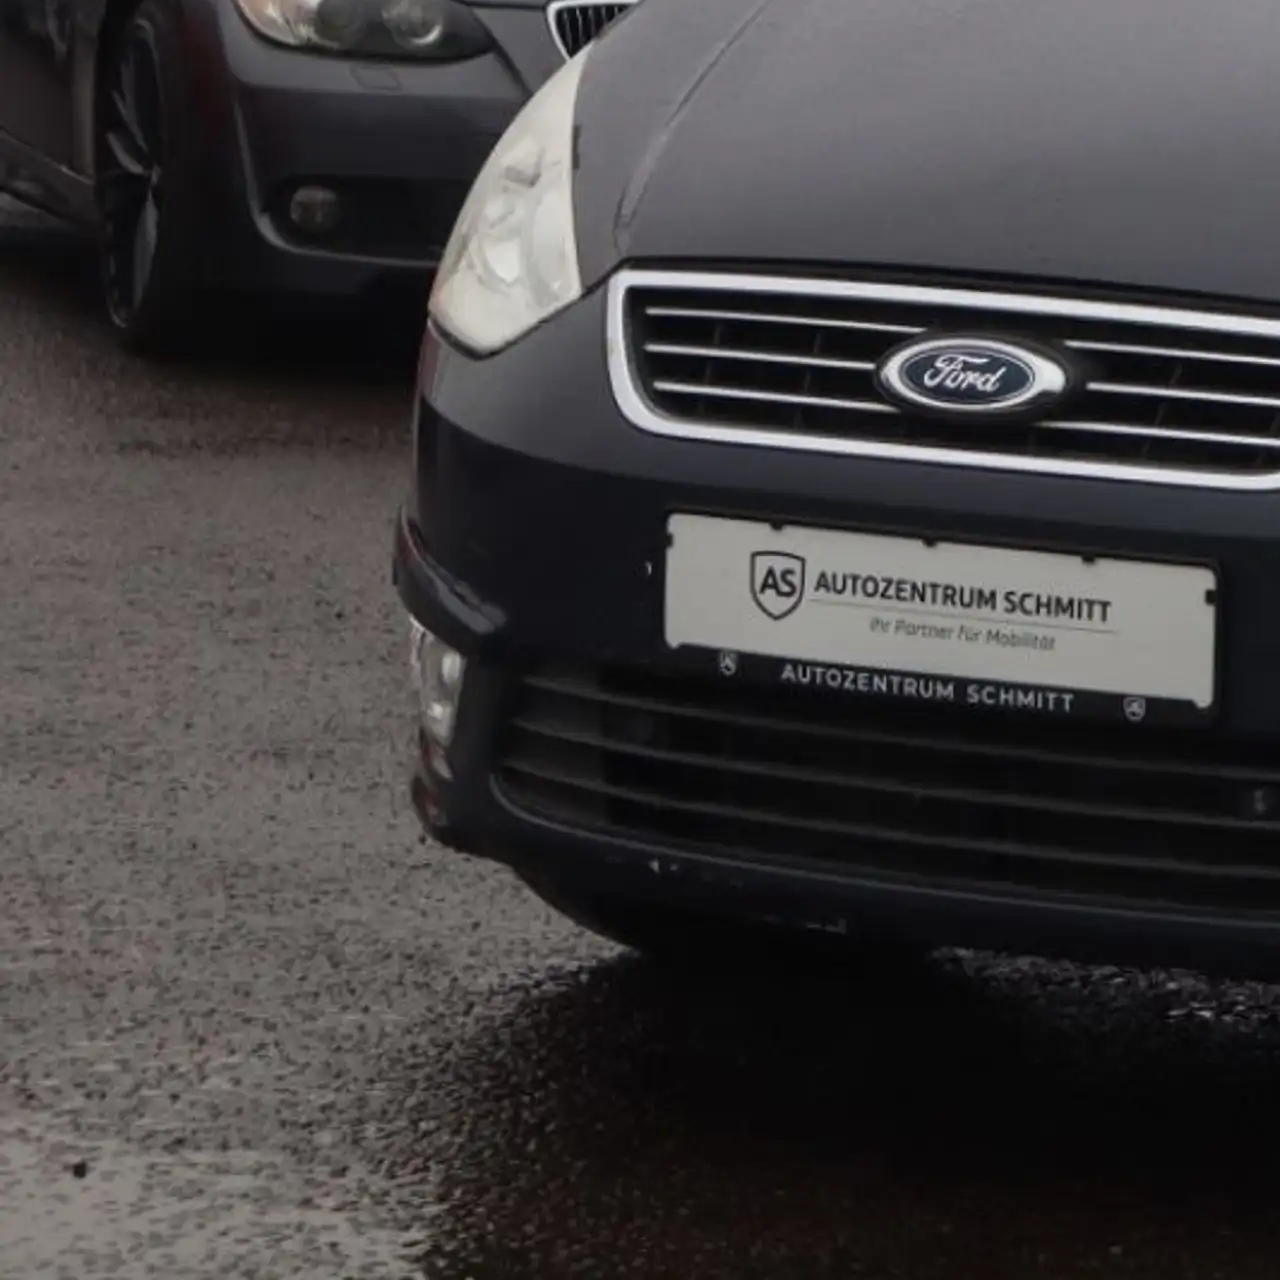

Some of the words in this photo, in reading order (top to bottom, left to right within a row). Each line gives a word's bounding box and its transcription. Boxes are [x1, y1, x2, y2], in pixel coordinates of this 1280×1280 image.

[924, 355, 1006, 391] Ford
[759, 566, 797, 597] AS
[814, 570, 997, 611] AUTOZENTRUM
[1003, 590, 1112, 623] SCHMITT
[894, 618, 953, 641] Partner
[957, 624, 982, 642] für
[986, 628, 1056, 651] Mobilität
[781, 663, 954, 701] AUTOZENTRUM
[966, 683, 1075, 713] SCHMITT
